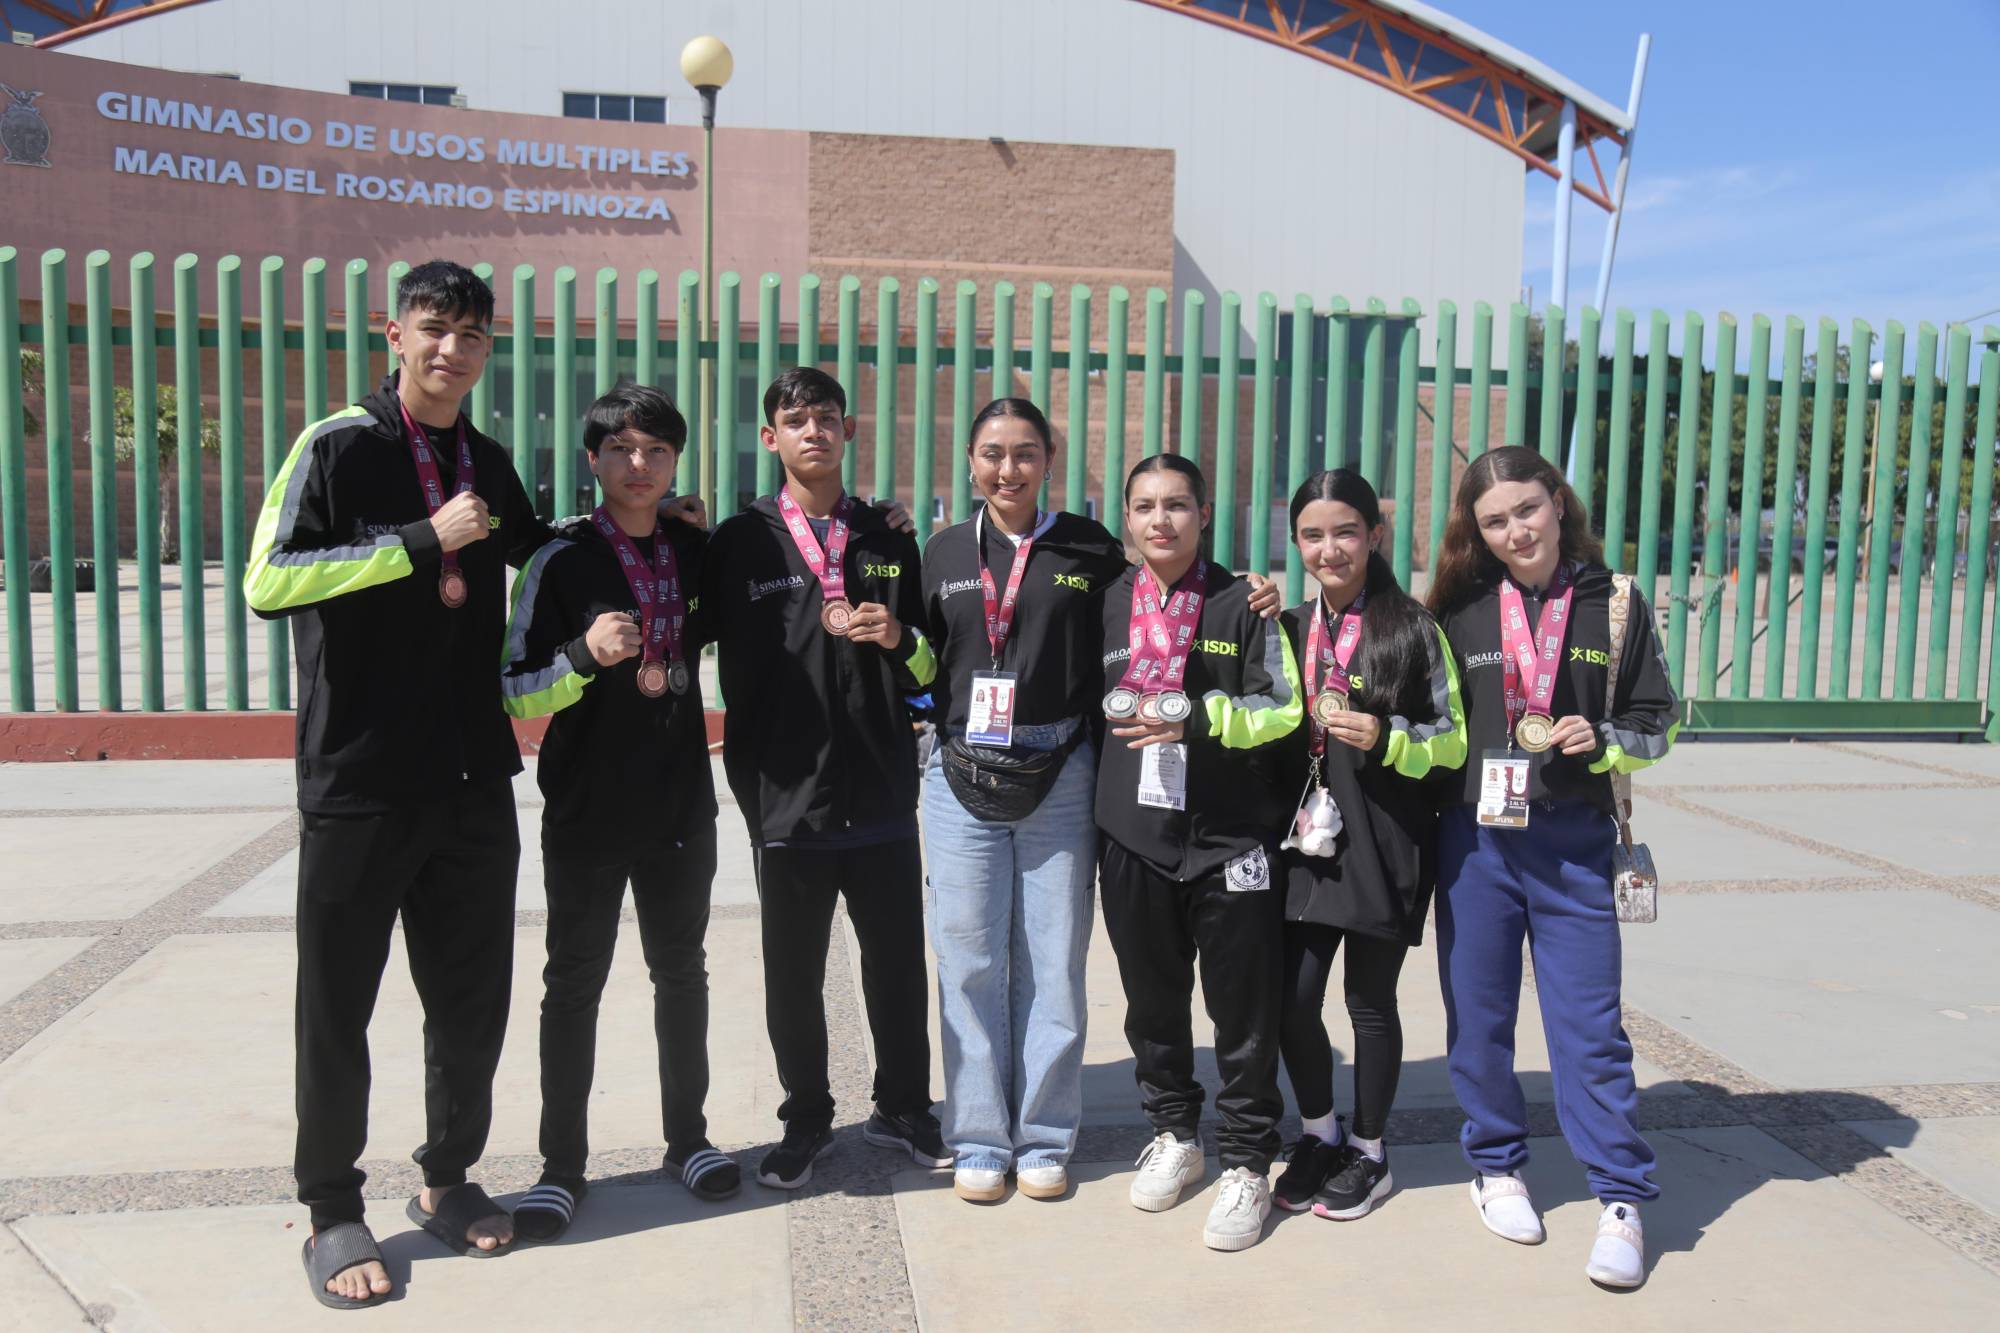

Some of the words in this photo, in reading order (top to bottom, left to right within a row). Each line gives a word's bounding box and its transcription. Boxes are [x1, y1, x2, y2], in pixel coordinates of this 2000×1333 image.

[97, 90, 312, 145] GIMNASIO
[325, 120, 376, 151] DE
[389, 127, 486, 162] USOS
[497, 137, 690, 176] MULTIPLES
[115, 146, 247, 186] MARIA
[257, 164, 326, 195] DEL
[336, 172, 493, 209] ROSARIO
[504, 187, 671, 220] ESPINOZA
[877, 564, 901, 578] ISD
[759, 575, 804, 593] SINALOA
[948, 578, 983, 592] SINALO
[1068, 575, 1090, 593] ISDE
[1204, 639, 1239, 657] ISDE
[1467, 651, 1503, 666] SINALO
[1586, 648, 1609, 667] ISD
